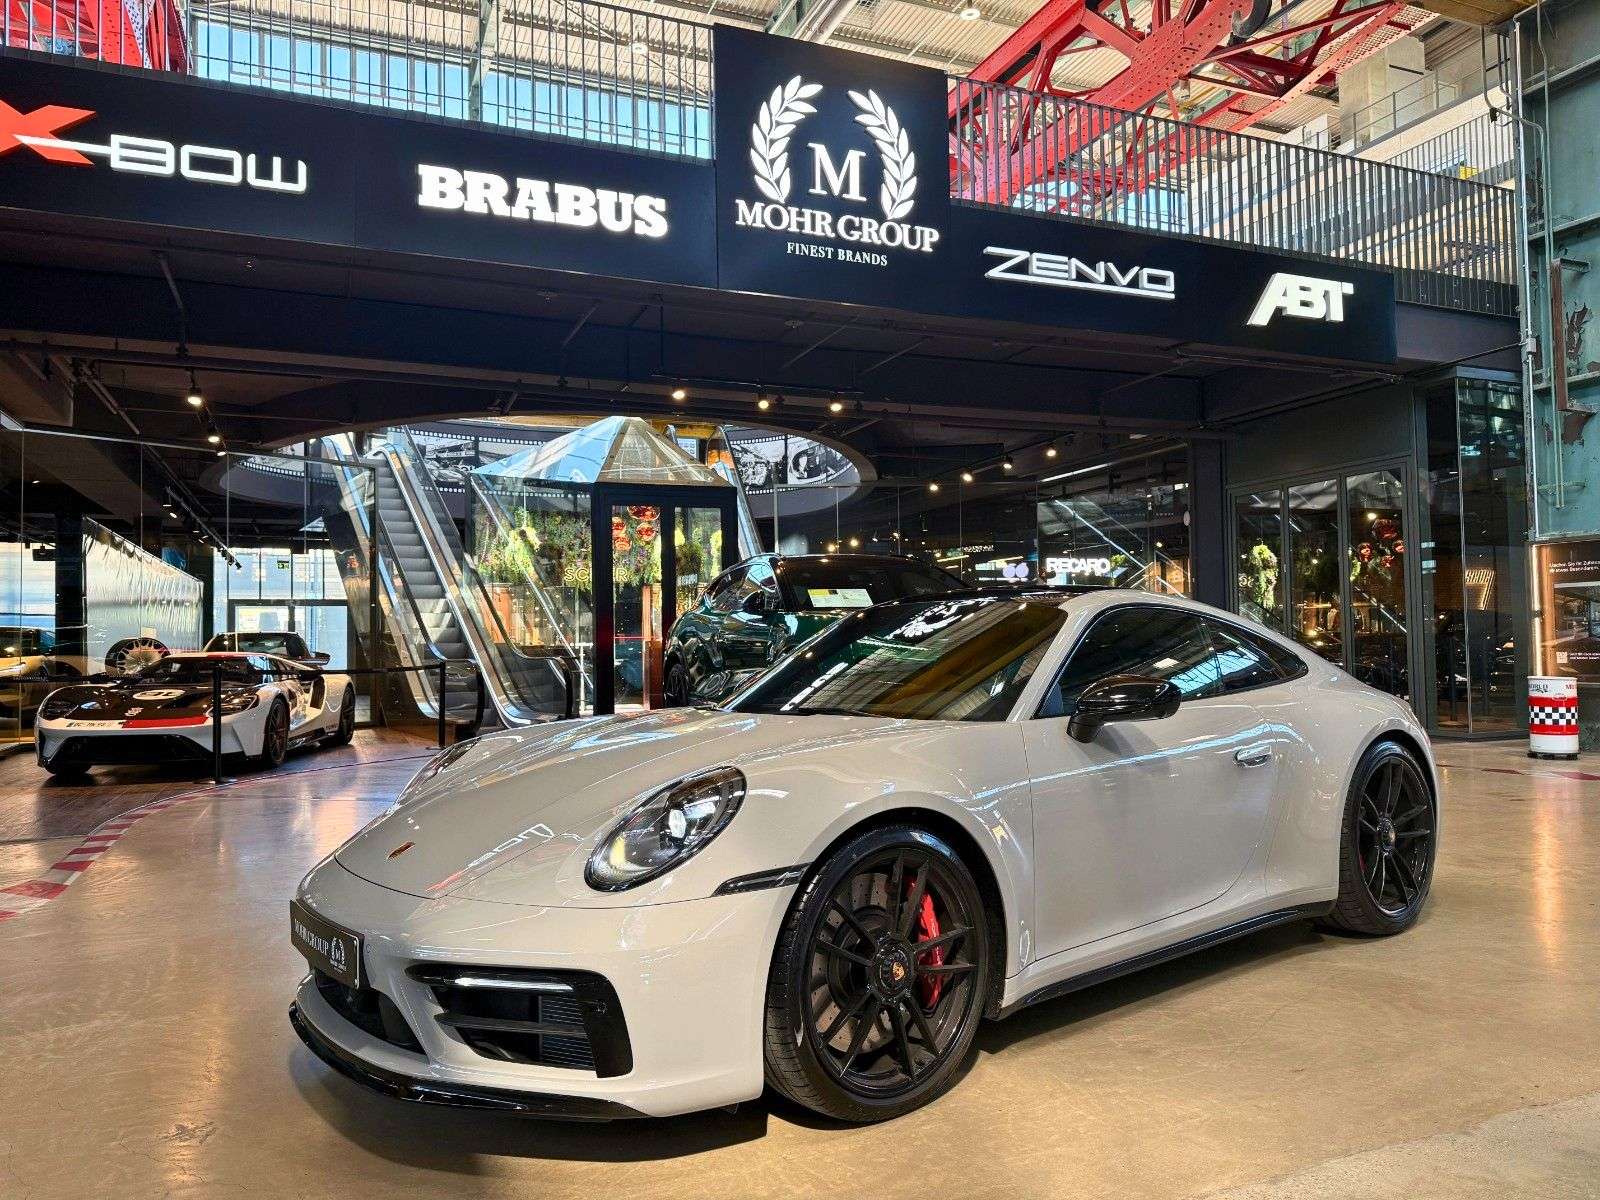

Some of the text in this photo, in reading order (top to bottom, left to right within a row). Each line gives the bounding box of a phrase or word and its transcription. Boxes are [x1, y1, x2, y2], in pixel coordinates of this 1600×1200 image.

[807, 142, 867, 203] M
[417, 164, 669, 238] BRABUS
[735, 198, 940, 253] MOHR GROUP
[787, 242, 889, 267] FINEST BRANDS
[983, 246, 1176, 300] ZENVO
[1246, 272, 1355, 326] ABT
[1046, 557, 1111, 577] RECARO
